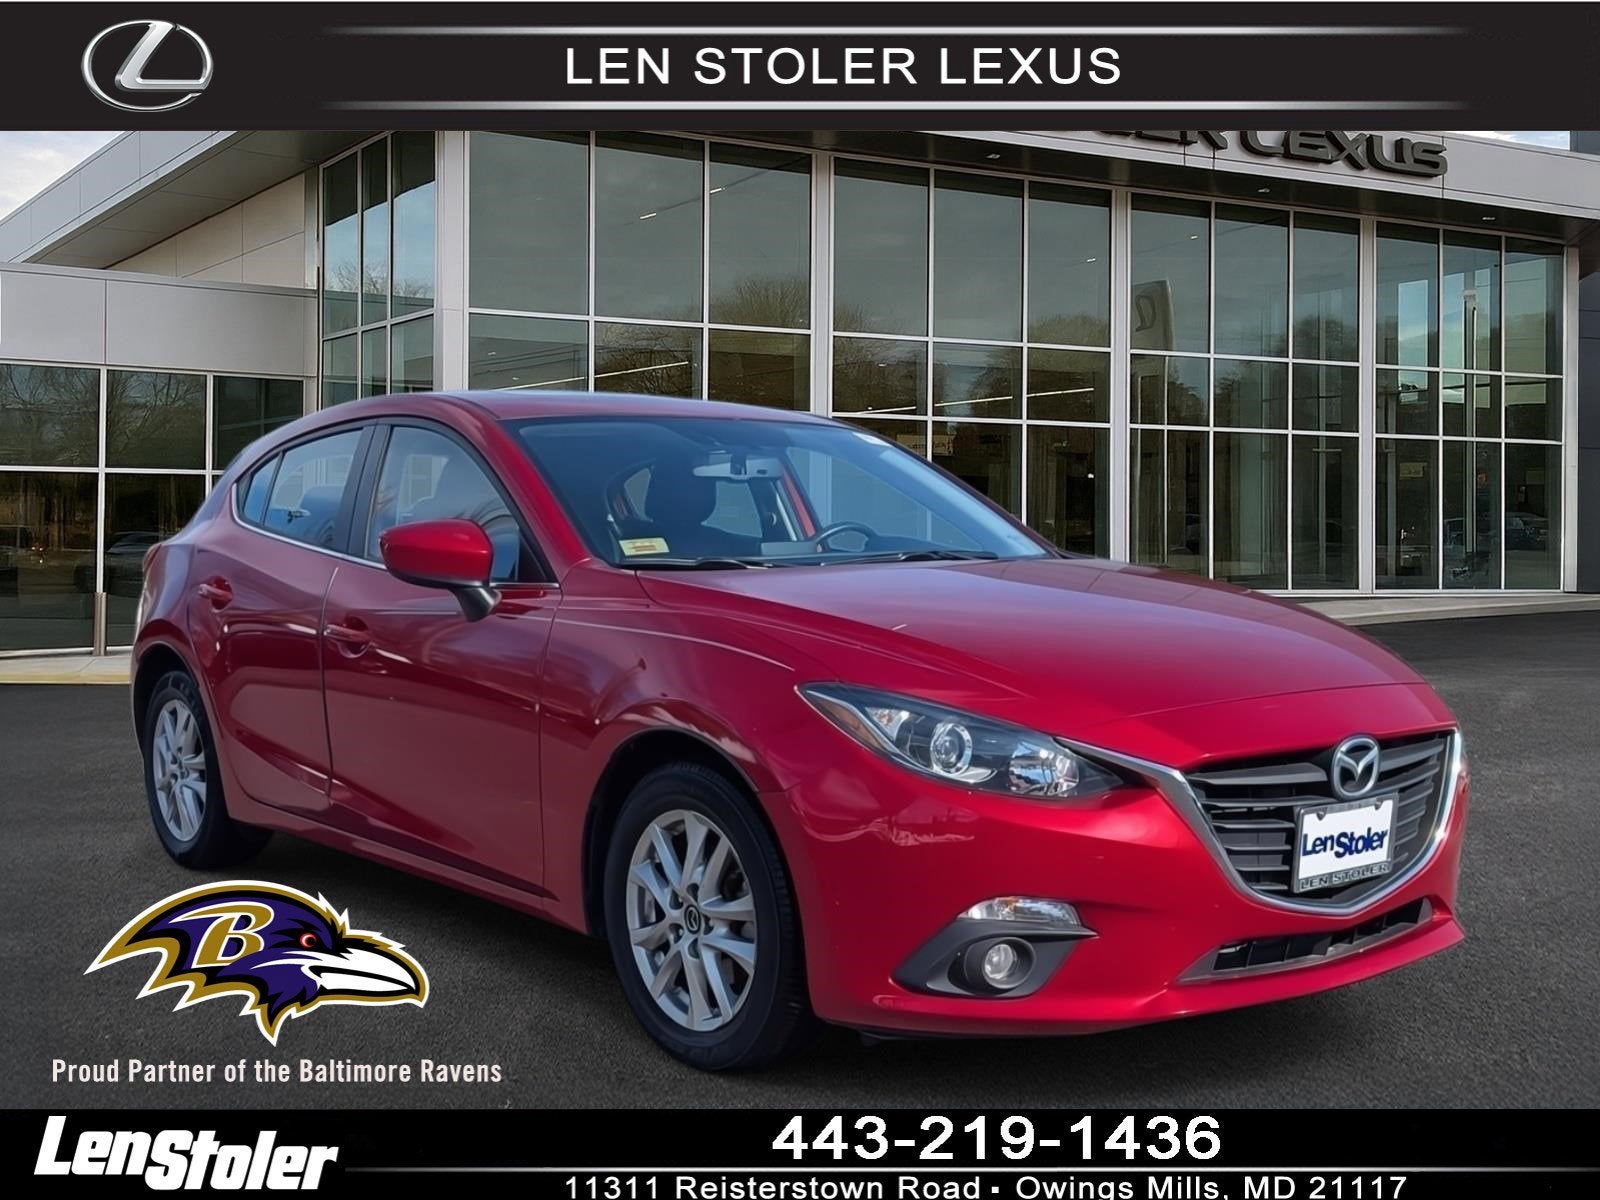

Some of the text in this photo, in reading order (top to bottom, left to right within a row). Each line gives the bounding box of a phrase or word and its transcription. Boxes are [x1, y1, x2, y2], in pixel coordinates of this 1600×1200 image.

[1240, 131, 1448, 177] LEXUS
[1301, 862, 1389, 889] LEN STOLER
